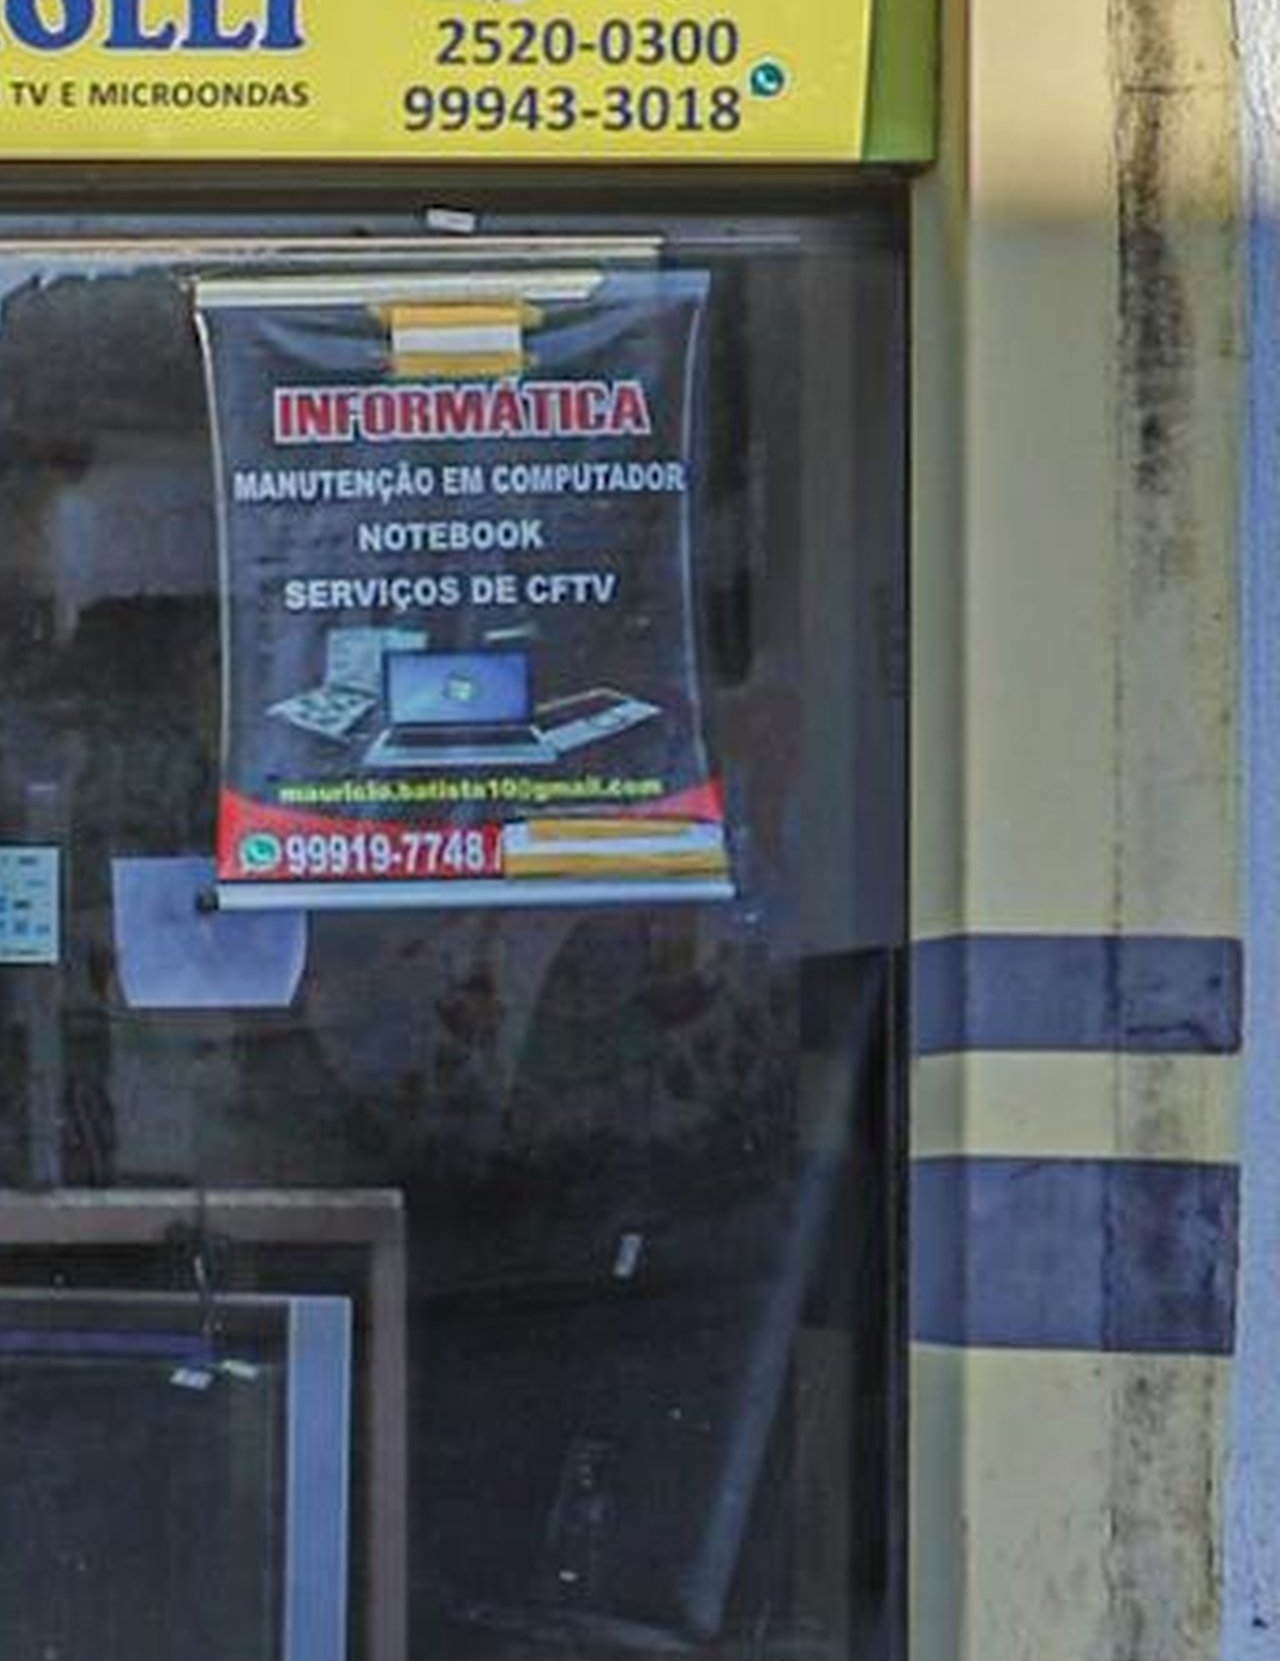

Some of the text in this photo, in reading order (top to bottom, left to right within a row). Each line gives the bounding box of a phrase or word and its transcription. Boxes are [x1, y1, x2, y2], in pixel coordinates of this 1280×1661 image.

[435, 18, 740, 66] 2520-0300
[11, 81, 49, 108] TV
[60, 81, 77, 108] E
[88, 81, 310, 109] MICROONDAS
[403, 85, 742, 133] 99943-3018
[274, 377, 652, 444] INFORMÁTICA
[234, 461, 688, 504] MANUTENÇÃO EM COMPUTADOR
[358, 520, 545, 554] NOTEBOOK
[283, 574, 616, 612] SERVIÇOS DE CFTV
[286, 832, 486, 874] 99919-7748
